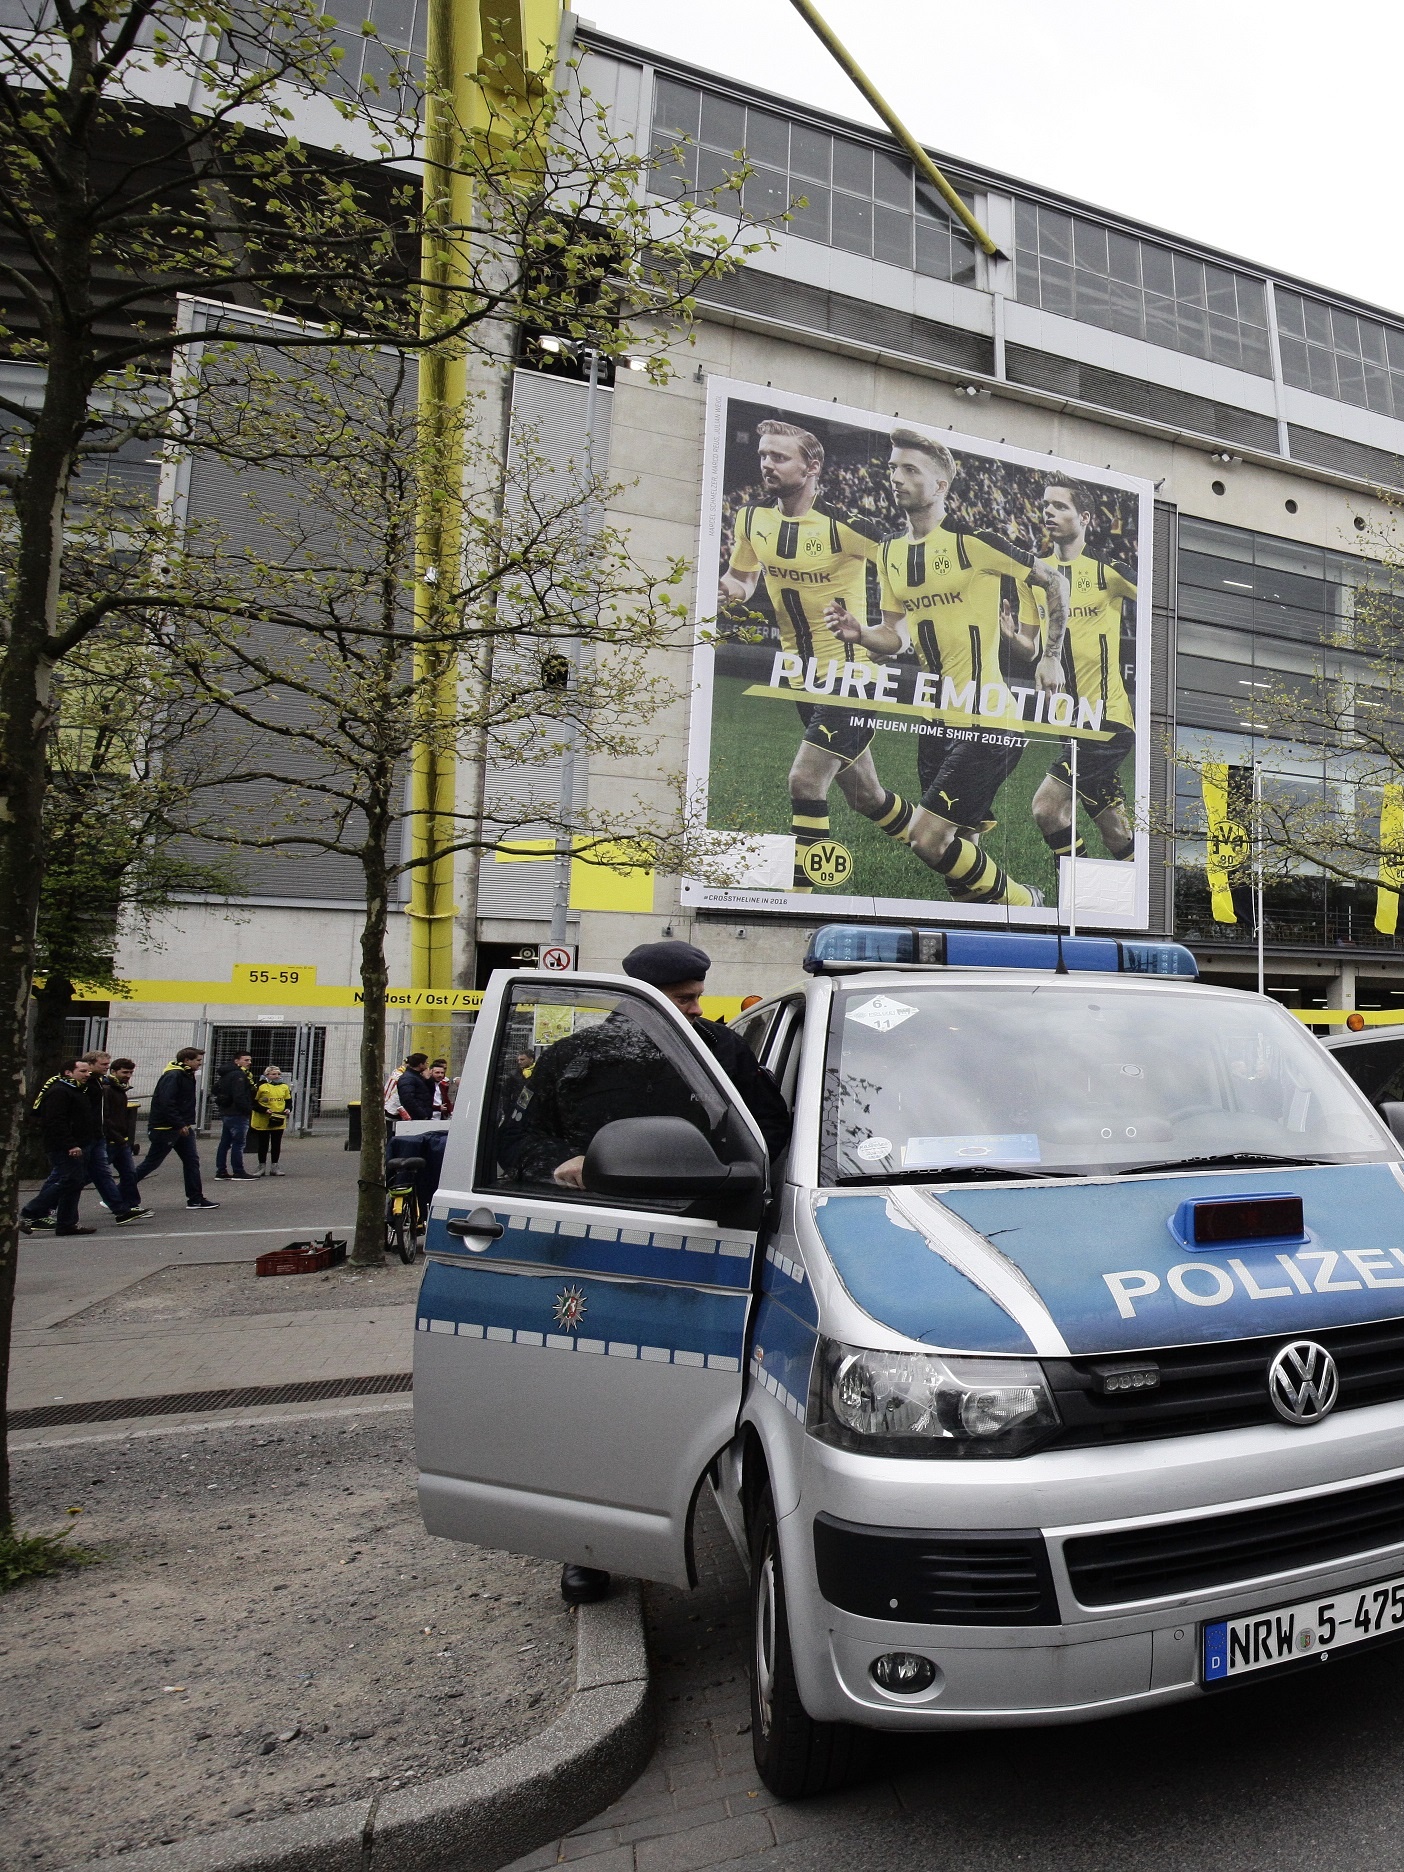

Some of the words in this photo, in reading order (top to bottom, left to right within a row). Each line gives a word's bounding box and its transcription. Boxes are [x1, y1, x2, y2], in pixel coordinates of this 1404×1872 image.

[768, 566, 831, 583] EVONIK
[769, 651, 901, 704] PURE
[912, 671, 1104, 732] EMOTION
[850, 716, 864, 727] IM
[867, 718, 908, 733] NEUEN
[910, 723, 944, 738] HOME
[946, 728, 980, 743] SHIRT
[981, 733, 1030, 748] 2016/17
[810, 845, 847, 873] BVB
[820, 872, 834, 882] 09
[704, 894, 760, 904] #CROSSTHELINE
[249, 970, 299, 984] 55-59
[354, 992, 411, 1005] Ndost
[426, 994, 448, 1005] Ost
[1229, 1613, 1295, 1668] NRW
[1211, 1656, 1221, 1669] D
